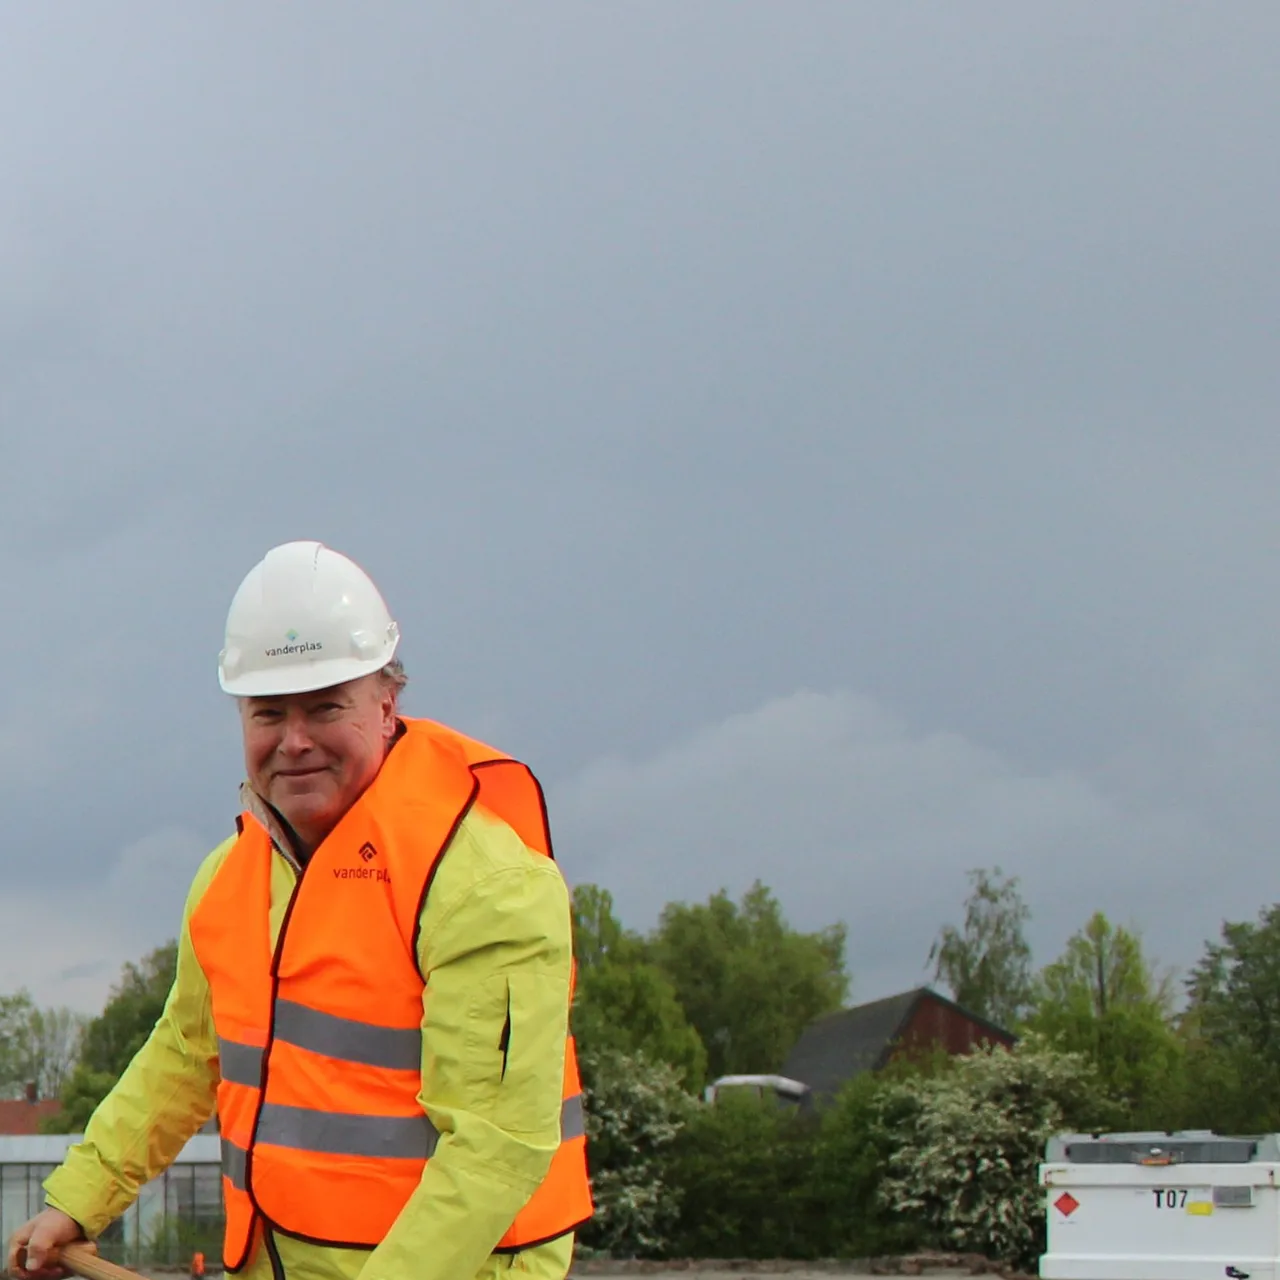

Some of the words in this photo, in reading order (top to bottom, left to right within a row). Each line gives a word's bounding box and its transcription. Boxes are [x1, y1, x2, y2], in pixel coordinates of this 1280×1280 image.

[264, 641, 323, 657] vanderplas
[332, 866, 392, 884] vanderpl
[1152, 1189, 1189, 1209] T07
